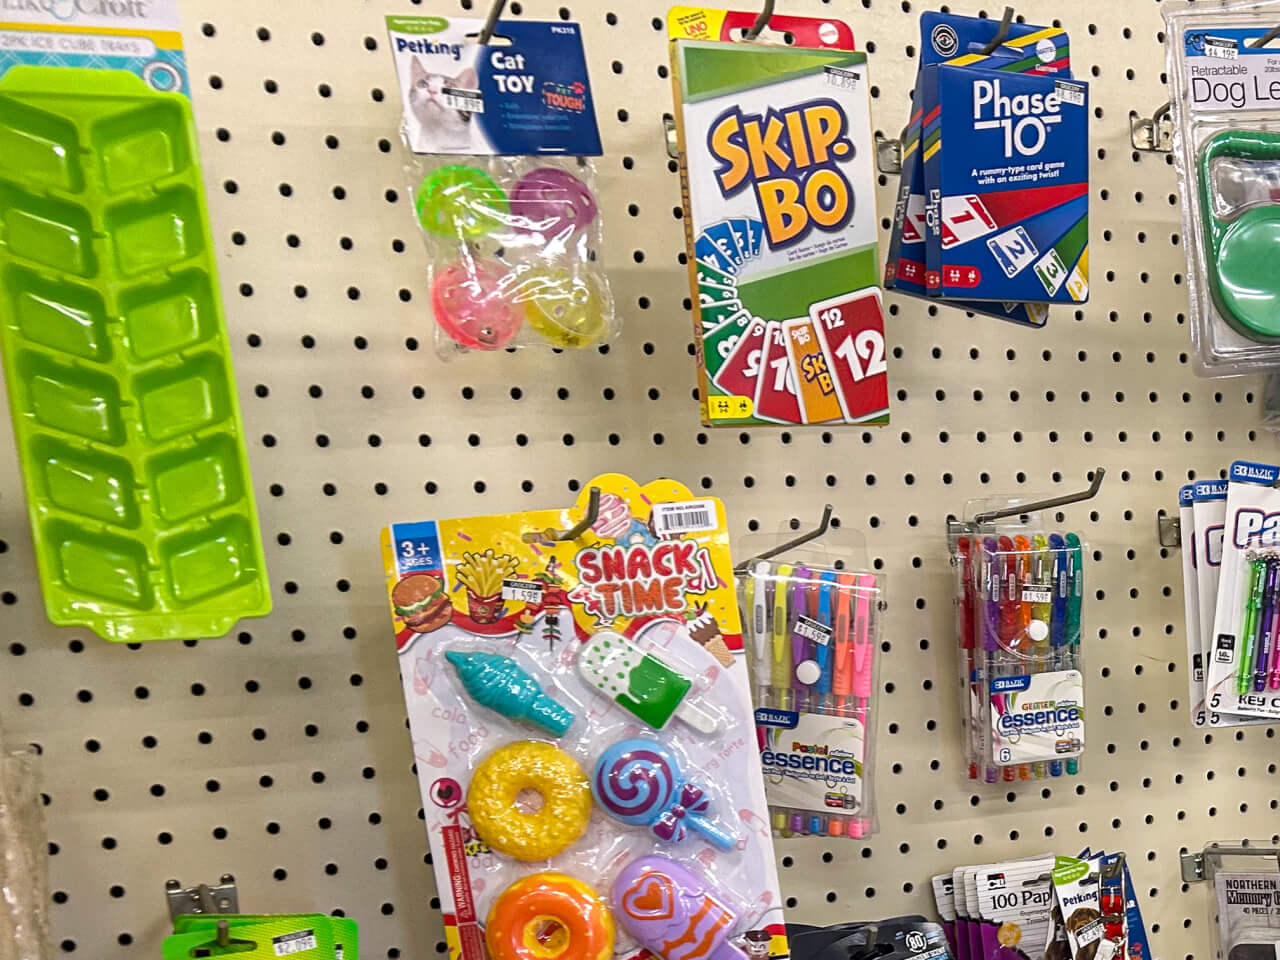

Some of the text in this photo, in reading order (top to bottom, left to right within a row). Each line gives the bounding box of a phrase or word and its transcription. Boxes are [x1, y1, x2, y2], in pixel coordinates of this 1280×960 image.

[684, 21, 708, 36] UNO
[395, 36, 463, 60] Petking
[491, 52, 525, 70] Cat
[1190, 64, 1248, 76] Retractable
[493, 74, 534, 94] TOY
[1192, 77, 1246, 109] Dog
[546, 92, 583, 110] TOUGH
[973, 79, 1062, 120] Phase
[1003, 116, 1047, 158] 10
[971, 161, 1065, 177] A rummy-type card game
[977, 169, 1060, 185] with an exciting twist!
[755, 165, 852, 249] BO
[820, 308, 845, 330] 12
[834, 328, 888, 383] 12
[401, 540, 431, 557] 3+
[400, 557, 433, 568] AGES
[577, 541, 699, 582] SNACK
[597, 576, 685, 618] TIME
[1209, 693, 1220, 708] 5
[1238, 694, 1265, 707] KEY
[792, 742, 829, 755] Pastel
[1000, 748, 1011, 762] 6
[1225, 879, 1277, 890] NORTHERN
[991, 892, 1019, 910] 100
[1062, 890, 1099, 908] Petking
[1226, 889, 1273, 907] Memory
